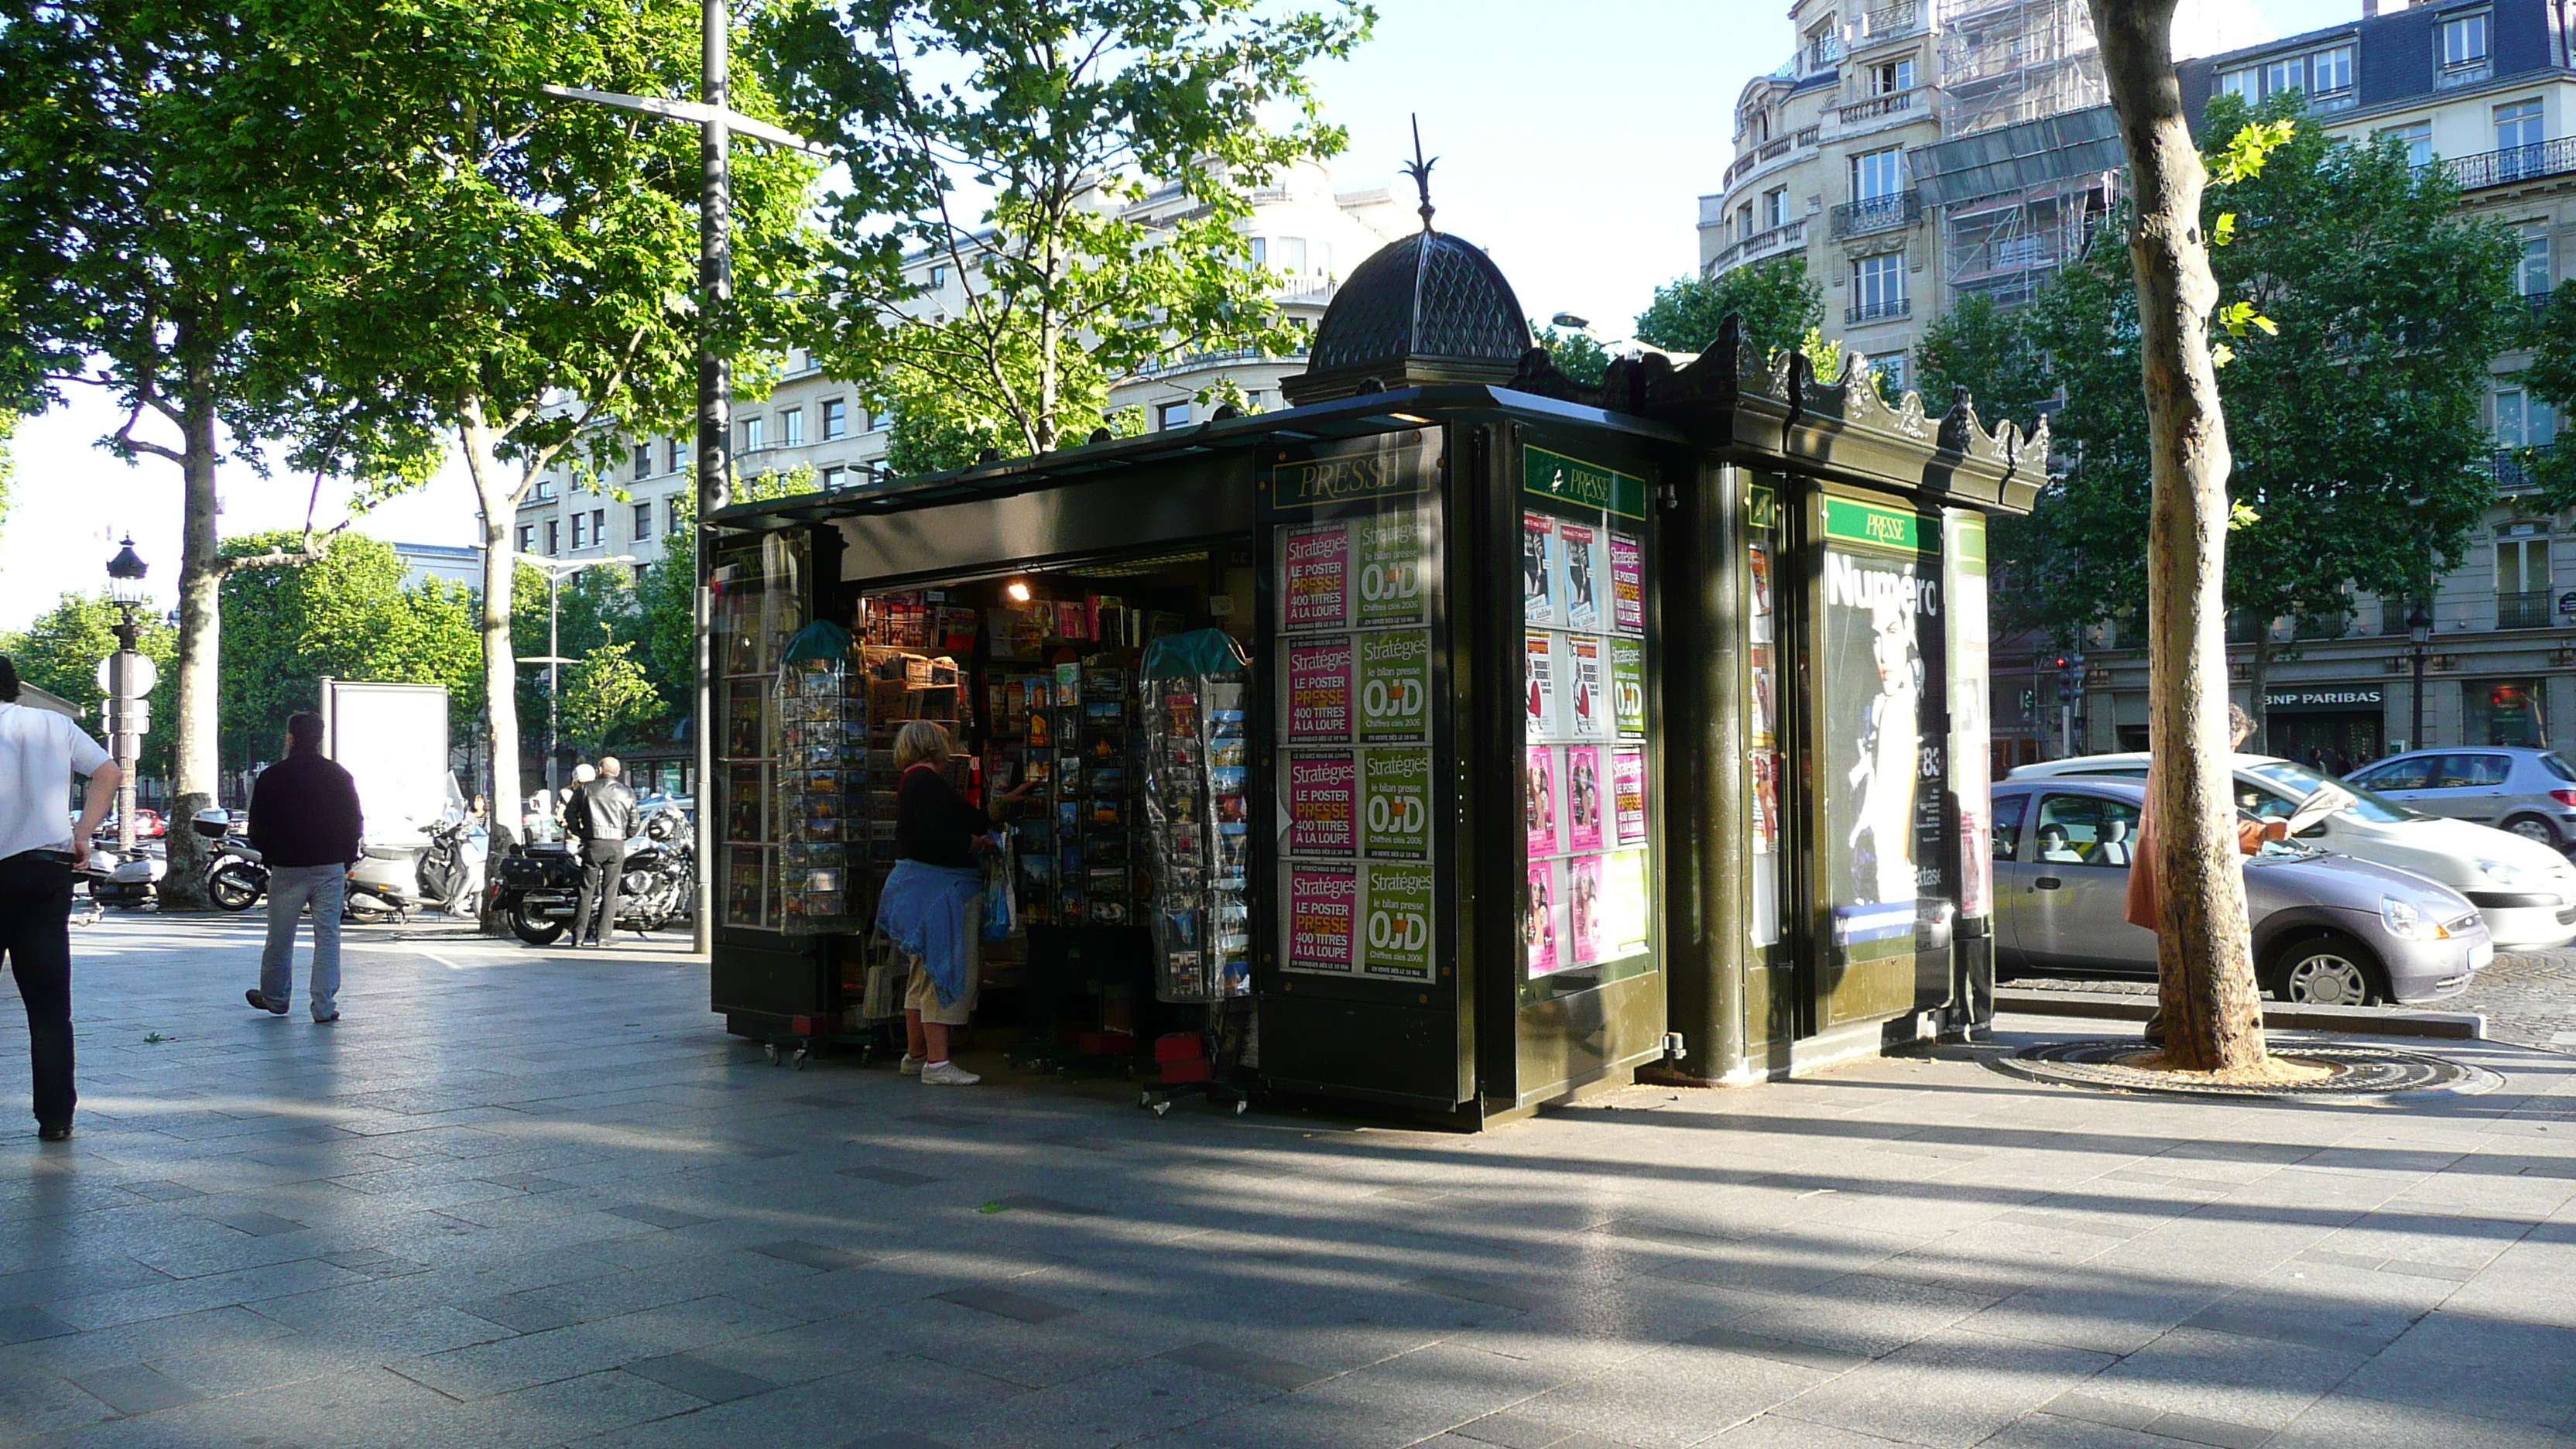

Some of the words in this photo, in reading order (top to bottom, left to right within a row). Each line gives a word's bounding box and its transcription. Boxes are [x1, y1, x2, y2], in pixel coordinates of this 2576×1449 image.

[1297, 456, 1397, 499] PRESSE
[1570, 468, 1610, 503] PRESSE
[1865, 513, 1905, 542] PRESSE
[1289, 536, 1347, 561] Stratégies
[1374, 552, 1391, 560] bilan
[1393, 550, 1417, 560] presse
[1611, 546, 1639, 568] Stratégies
[1291, 566, 1302, 577] LE
[1306, 562, 1341, 576] POSTER
[1291, 575, 1341, 594] PRESSE
[1362, 561, 1420, 601] OJD
[1828, 552, 1937, 616] Numéro
[1291, 595, 1308, 607] 400
[1310, 593, 1341, 605] TITRES
[1291, 606, 1297, 619] À
[1300, 608, 1310, 618] LA
[1312, 605, 1341, 617] LOUPE
[1364, 638, 1427, 660] Stratégies
[1291, 649, 1351, 672] Stratégies
[1367, 667, 1375, 677] le
[1377, 667, 1394, 677] bilan
[1396, 667, 1420, 677] presse
[1295, 678, 1305, 689] LE
[1309, 677, 1345, 688] POSTER
[1294, 690, 1345, 706] PRESSE
[1363, 678, 1423, 717] OJD
[1615, 681, 1642, 716] OJD
[2264, 694, 2297, 705] BNP
[2303, 692, 2380, 704] PARIBAS
[1294, 707, 1311, 719] 400
[1314, 707, 1345, 718] TITRES
[1294, 718, 1300, 731] À
[1303, 721, 1313, 731] LA
[1316, 719, 1345, 731] LOUPE
[1405, 718, 1420, 727] 2006
[1293, 763, 1355, 785] Stratégies
[1367, 755, 1427, 778] Stratégies
[1297, 790, 1307, 801] LE
[1311, 790, 1348, 801] POSTER
[1371, 783, 1378, 792] le
[1379, 783, 1396, 793] bilan
[1398, 785, 1421, 794] presse
[1297, 803, 1350, 818] PRESSE
[1367, 795, 1425, 834] OJD
[1296, 820, 1314, 832] 400
[1317, 820, 1349, 831] TITRES
[1296, 831, 1303, 844] À
[1305, 833, 1316, 844] LA
[1319, 833, 1350, 844] LOUPE
[1406, 836, 1422, 844] 2006
[1294, 876, 1355, 899] Stratégies
[1371, 872, 1431, 896] Stratégies
[1297, 902, 1307, 913] LE
[1311, 903, 1348, 916] POSTER
[1373, 898, 1380, 908] le
[1382, 899, 1399, 909] bilan
[1400, 902, 1424, 911] presse
[1296, 916, 1348, 933] PRESSE
[1368, 910, 1427, 951] OJD
[1296, 933, 1314, 944] 400
[1316, 933, 1348, 945] TITRES
[1295, 943, 1302, 955] À
[1304, 946, 1314, 957] LA
[1317, 946, 1347, 958] LOUPE
[1407, 954, 1423, 962] 2006
